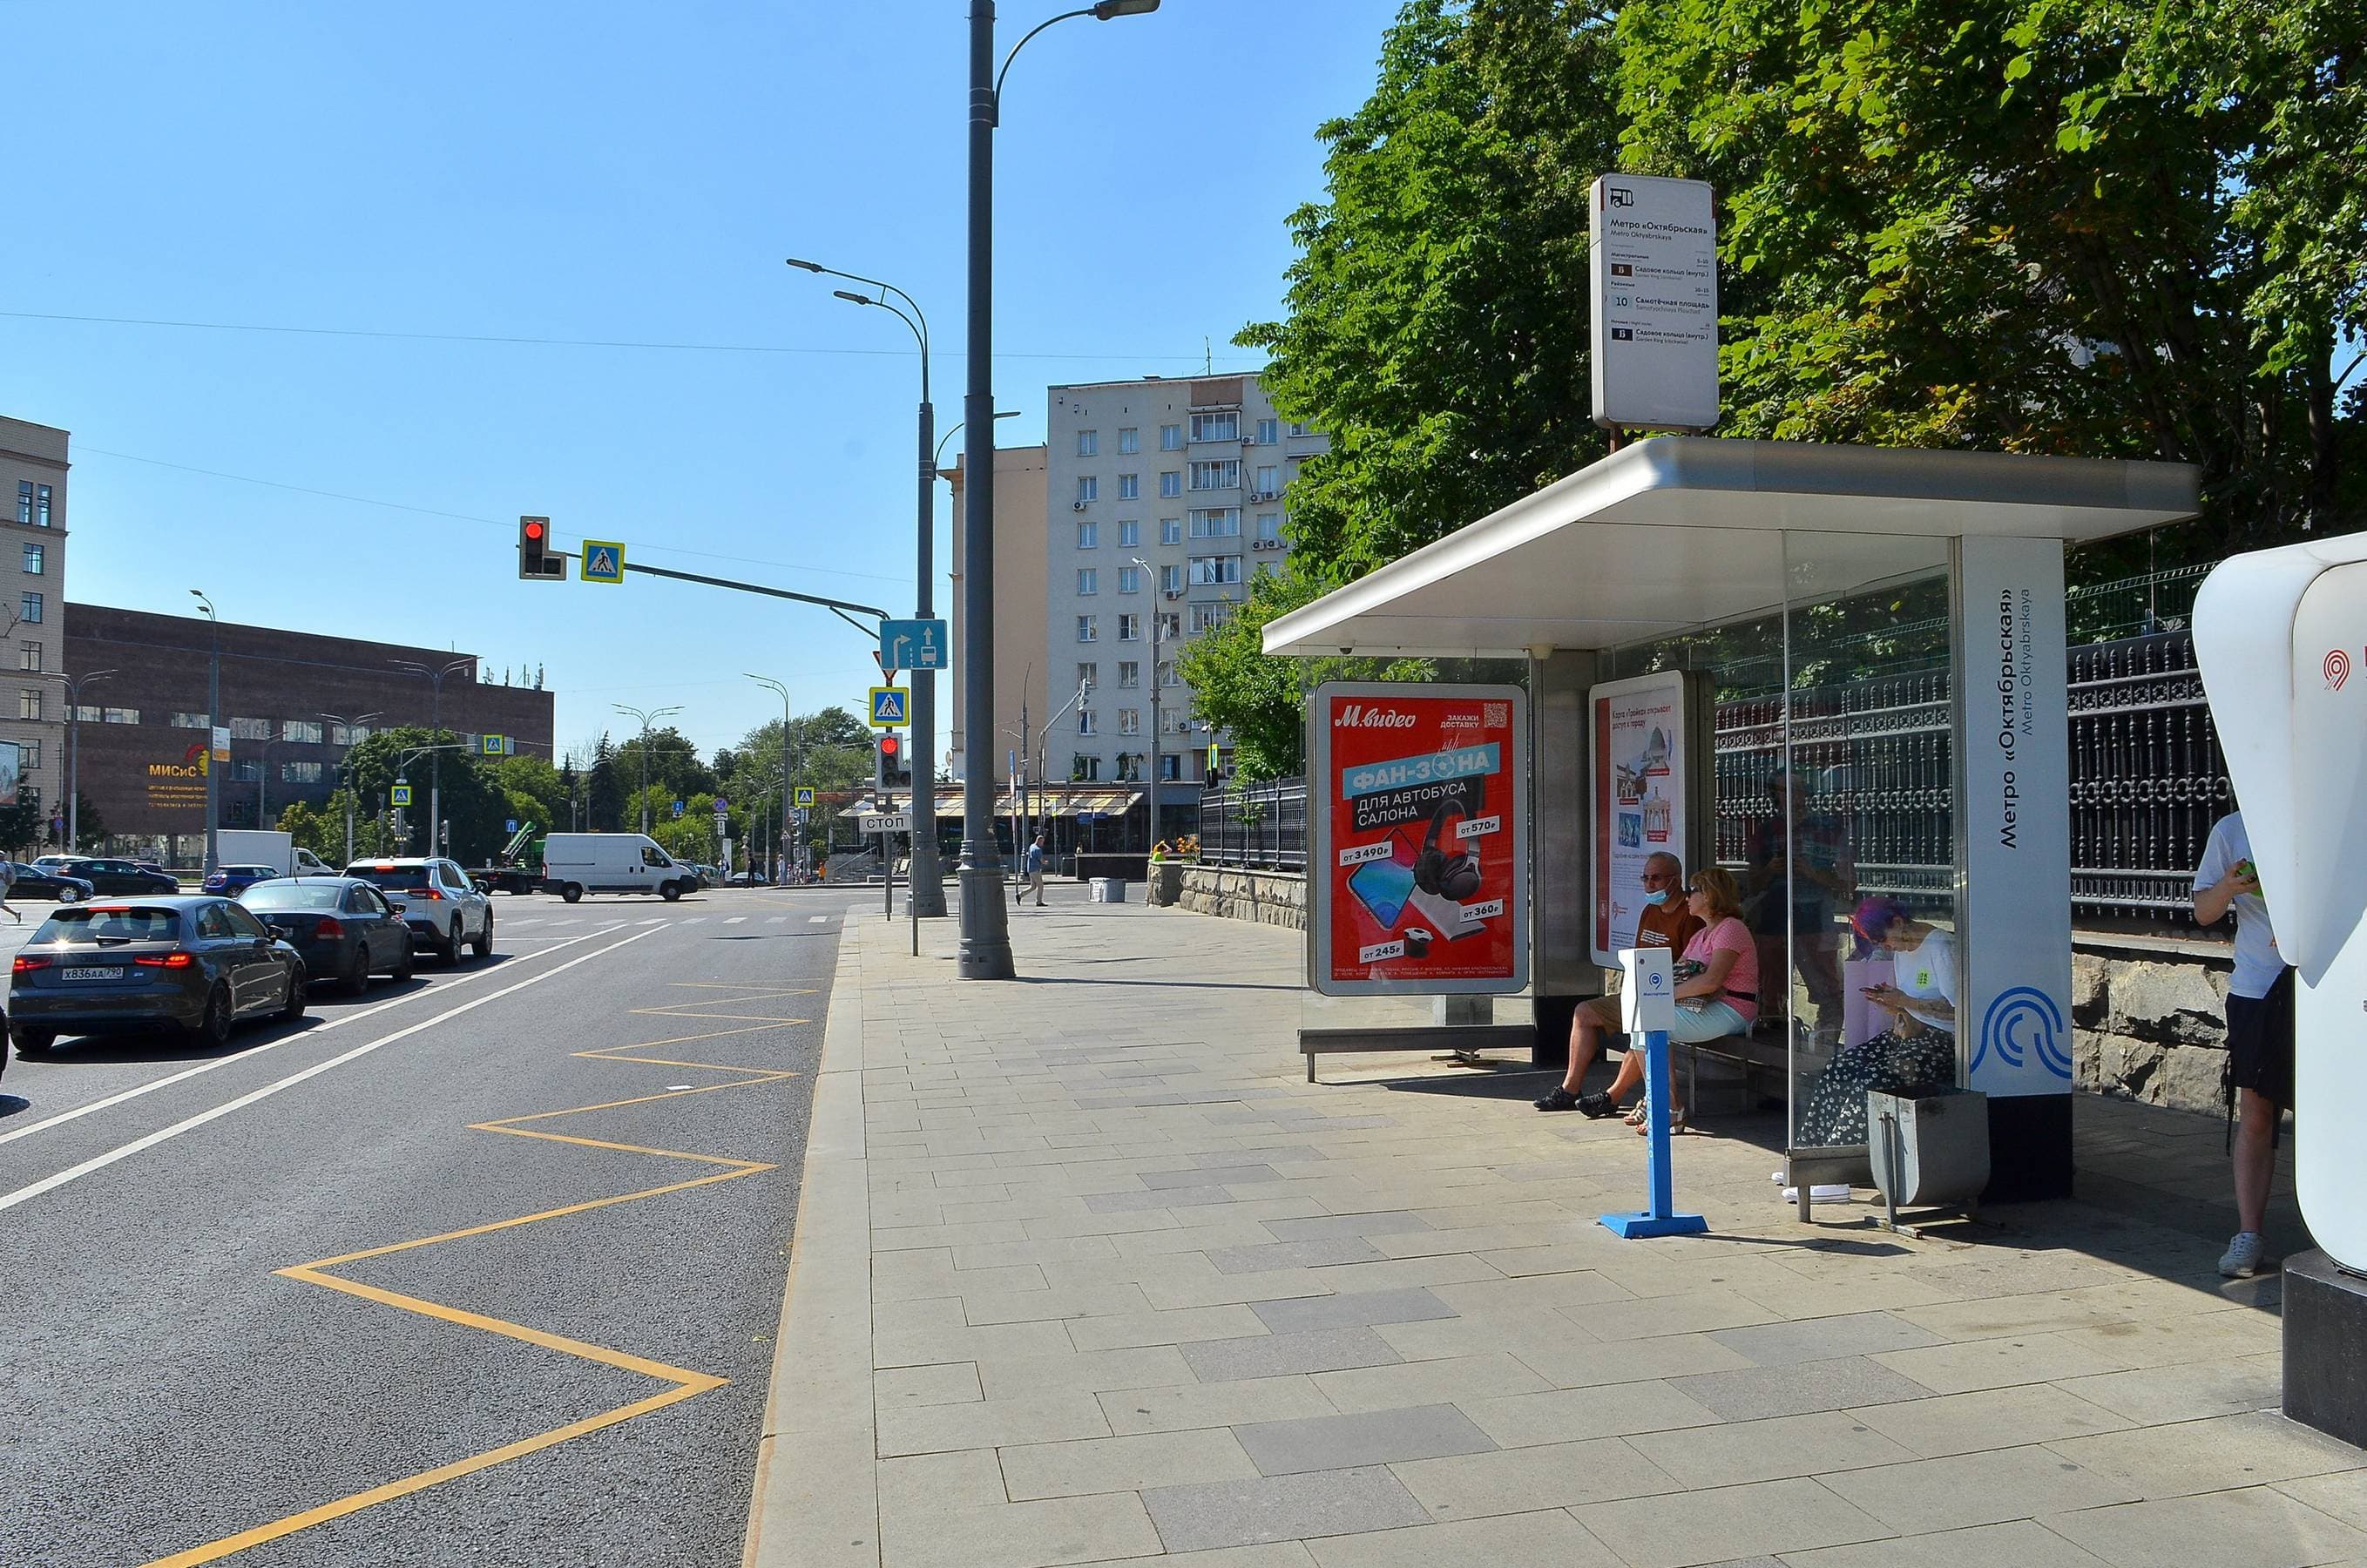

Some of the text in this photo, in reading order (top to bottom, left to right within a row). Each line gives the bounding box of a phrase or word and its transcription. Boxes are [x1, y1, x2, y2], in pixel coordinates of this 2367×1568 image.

[1610, 220, 1708, 234] Метро «Октябрьская»
[1616, 297, 1628, 307] 10
[2019, 589, 2033, 735] Metro Oktyabrskaya
[1997, 589, 2019, 849] Метро «Октябрьская»
[1357, 782, 1467, 814] ДЛЯ АВТОБУСА
[866, 817, 904, 828] СТОП
[1358, 806, 1417, 827] САЛОНА
